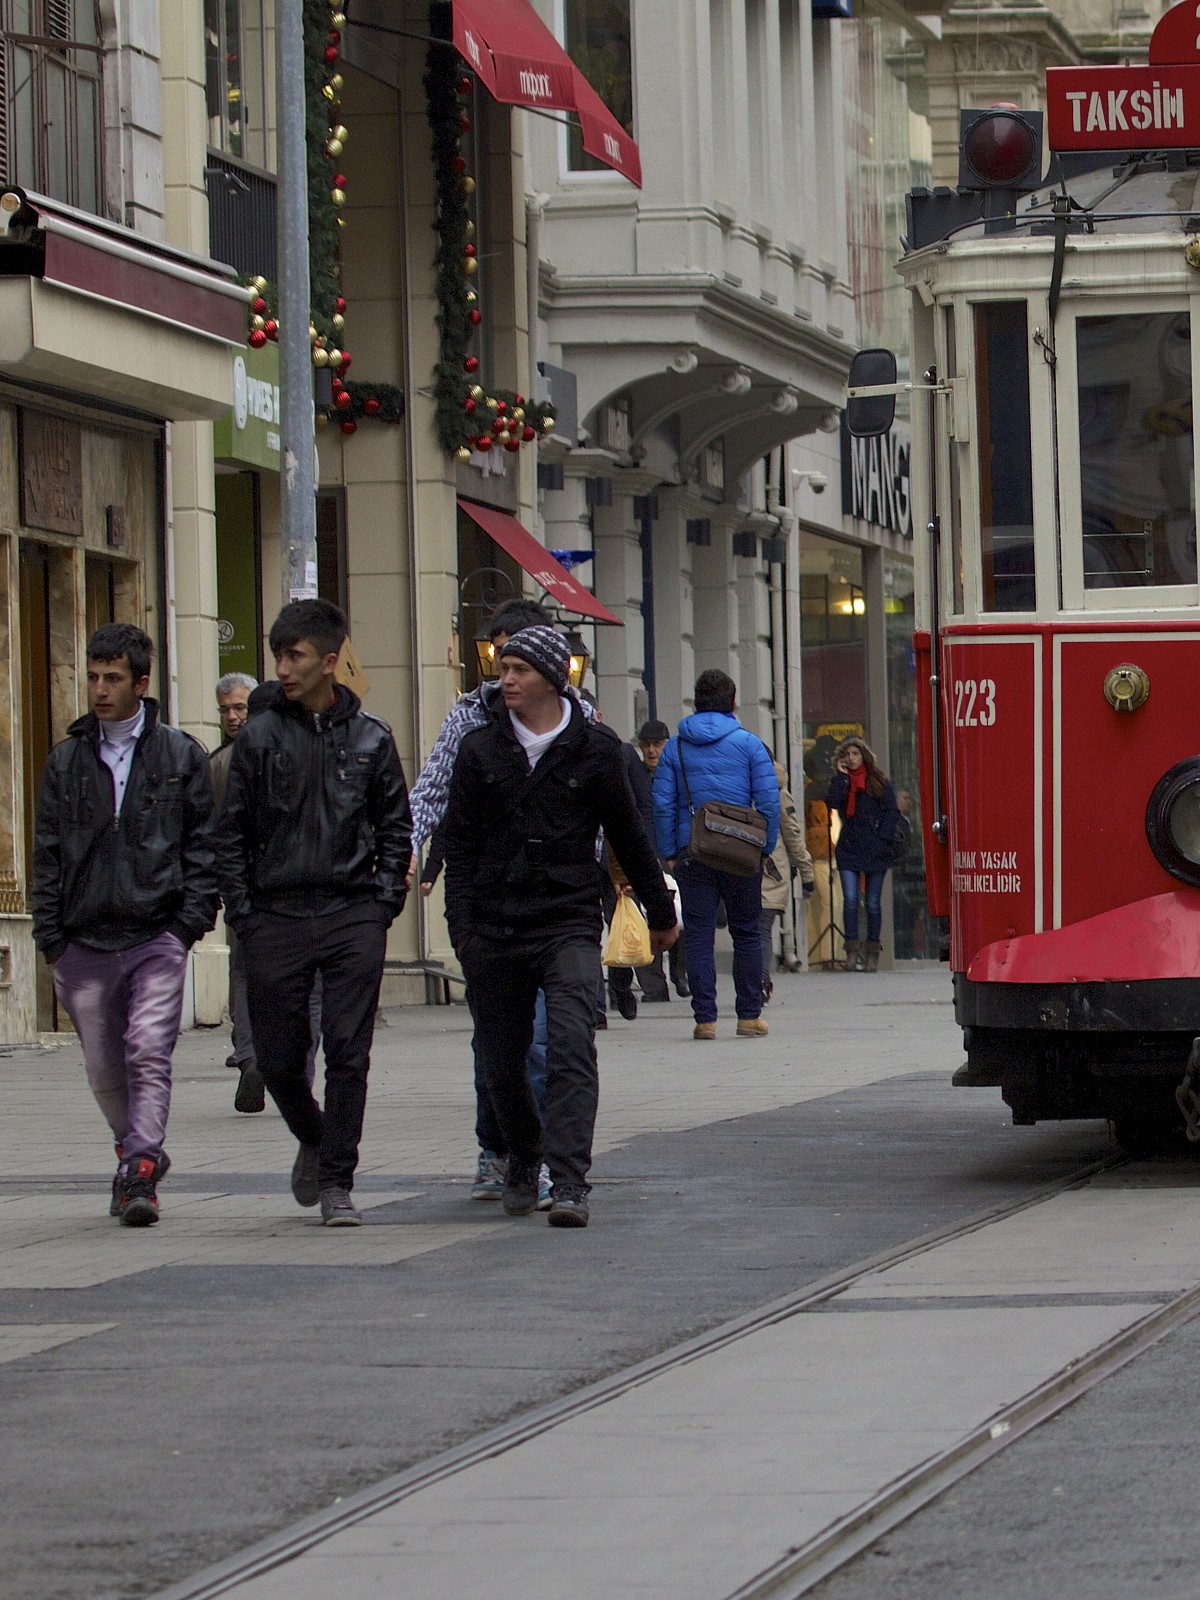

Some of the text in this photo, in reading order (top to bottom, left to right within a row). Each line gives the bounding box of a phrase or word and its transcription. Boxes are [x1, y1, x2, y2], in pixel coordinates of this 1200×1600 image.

[1066, 80, 1184, 132] TAKSİM
[954, 678, 996, 727] 223
[980, 851, 1018, 870] YASAK
